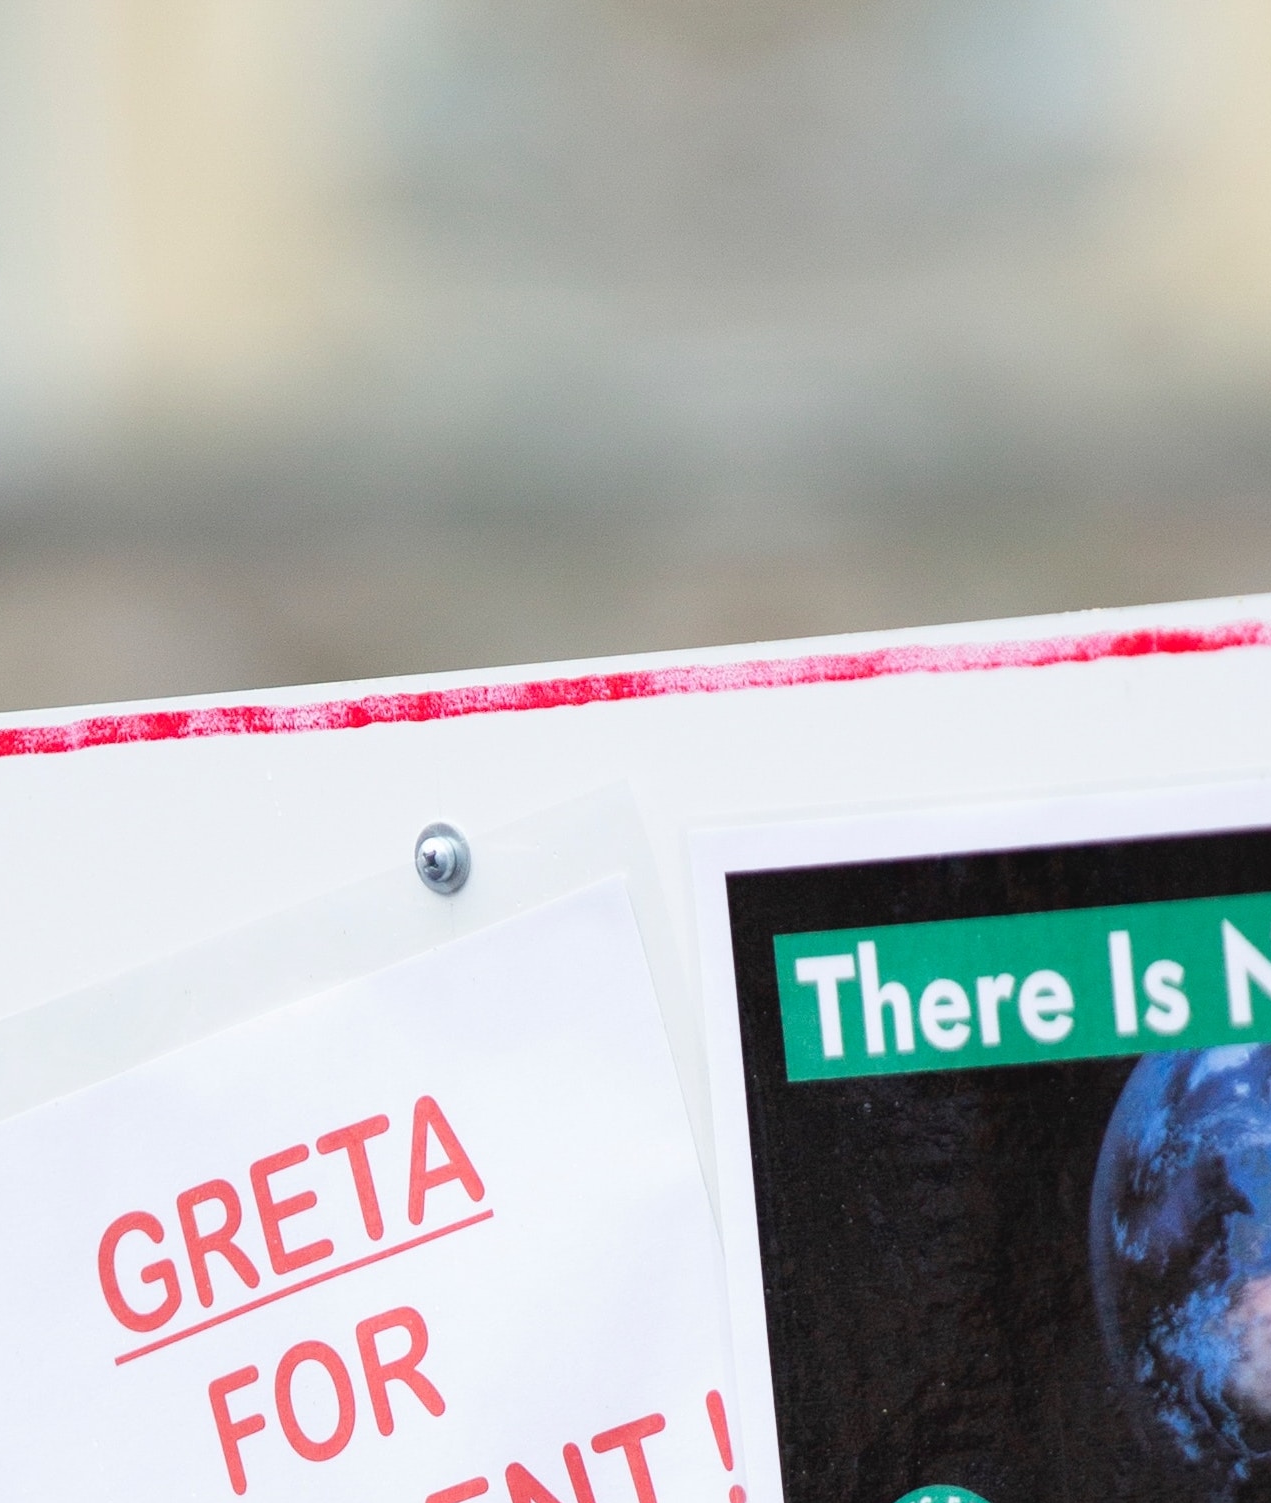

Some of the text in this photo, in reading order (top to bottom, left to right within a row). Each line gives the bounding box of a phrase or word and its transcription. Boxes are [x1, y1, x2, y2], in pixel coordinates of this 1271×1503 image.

[794, 940, 1075, 1059] There
[1108, 930, 1190, 1036] Is
[98, 1095, 486, 1332] GRETA
[208, 1306, 446, 1496] FOR
